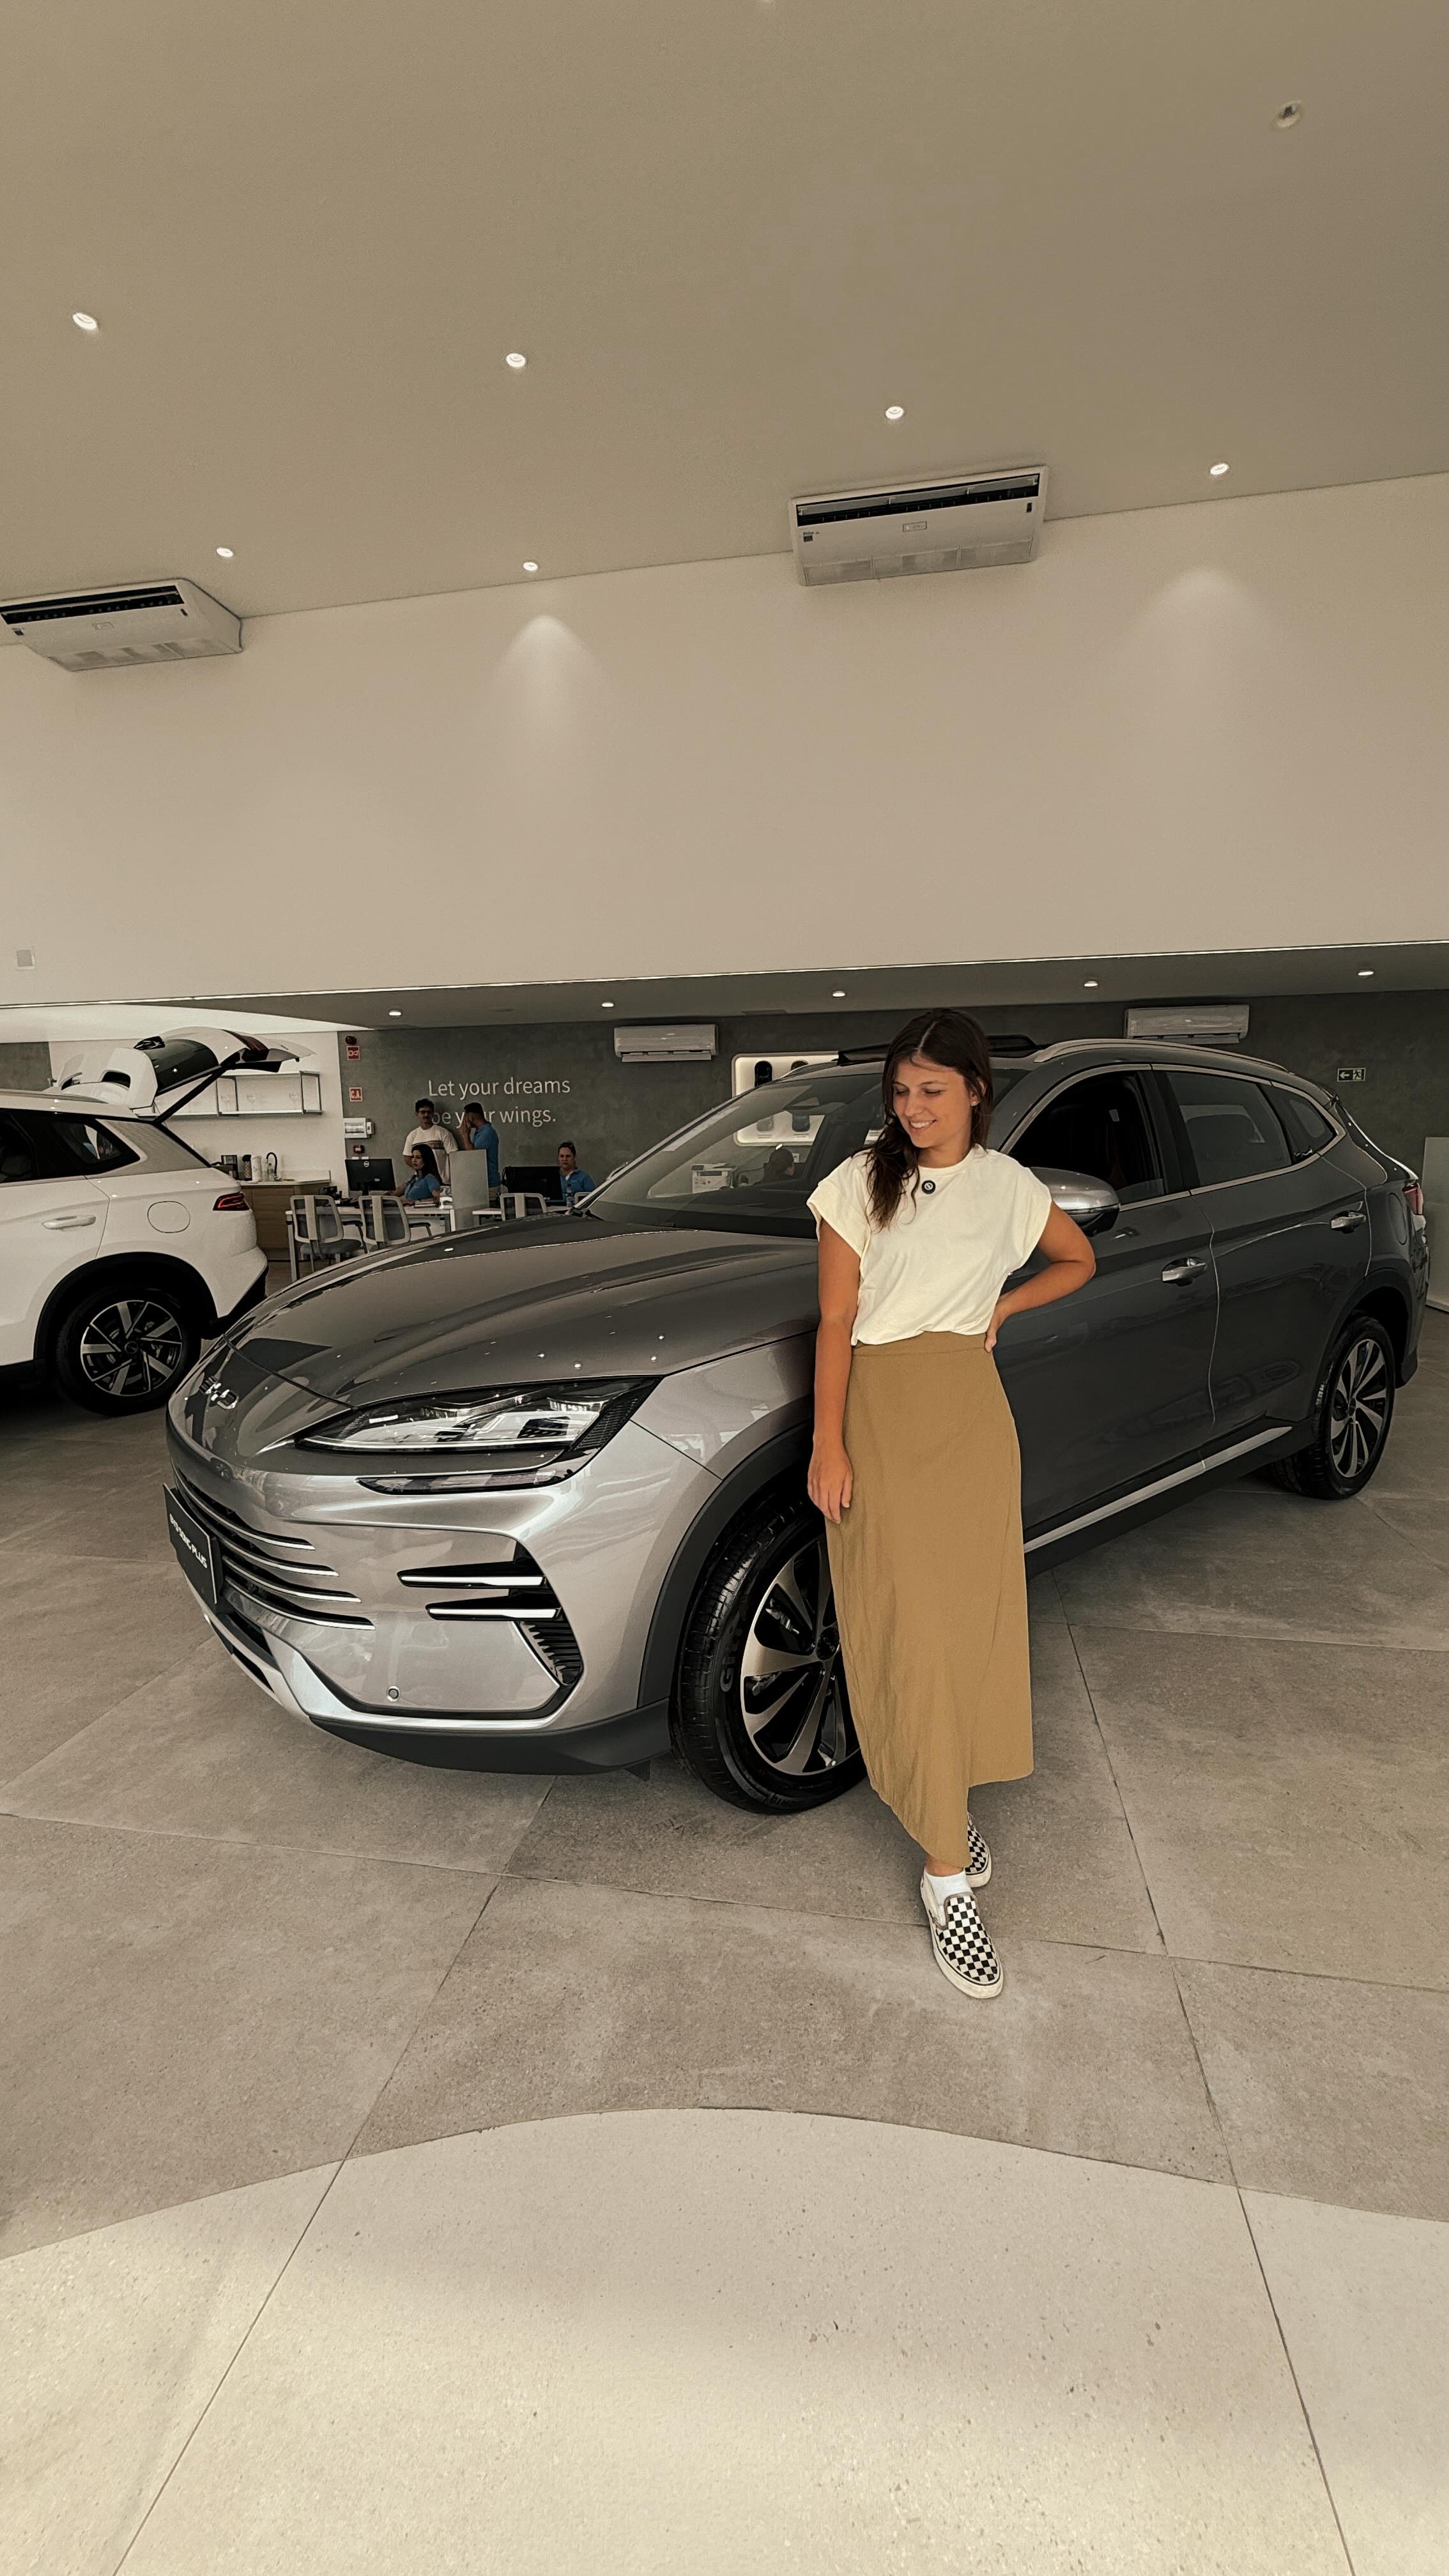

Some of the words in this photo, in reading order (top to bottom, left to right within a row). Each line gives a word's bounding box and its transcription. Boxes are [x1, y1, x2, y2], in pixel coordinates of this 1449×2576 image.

[428, 1080, 456, 1096] Let
[459, 1082, 499, 1100] your
[503, 1077, 571, 1094] dreams
[455, 1110, 495, 1129] yr
[500, 1106, 556, 1128] wings.
